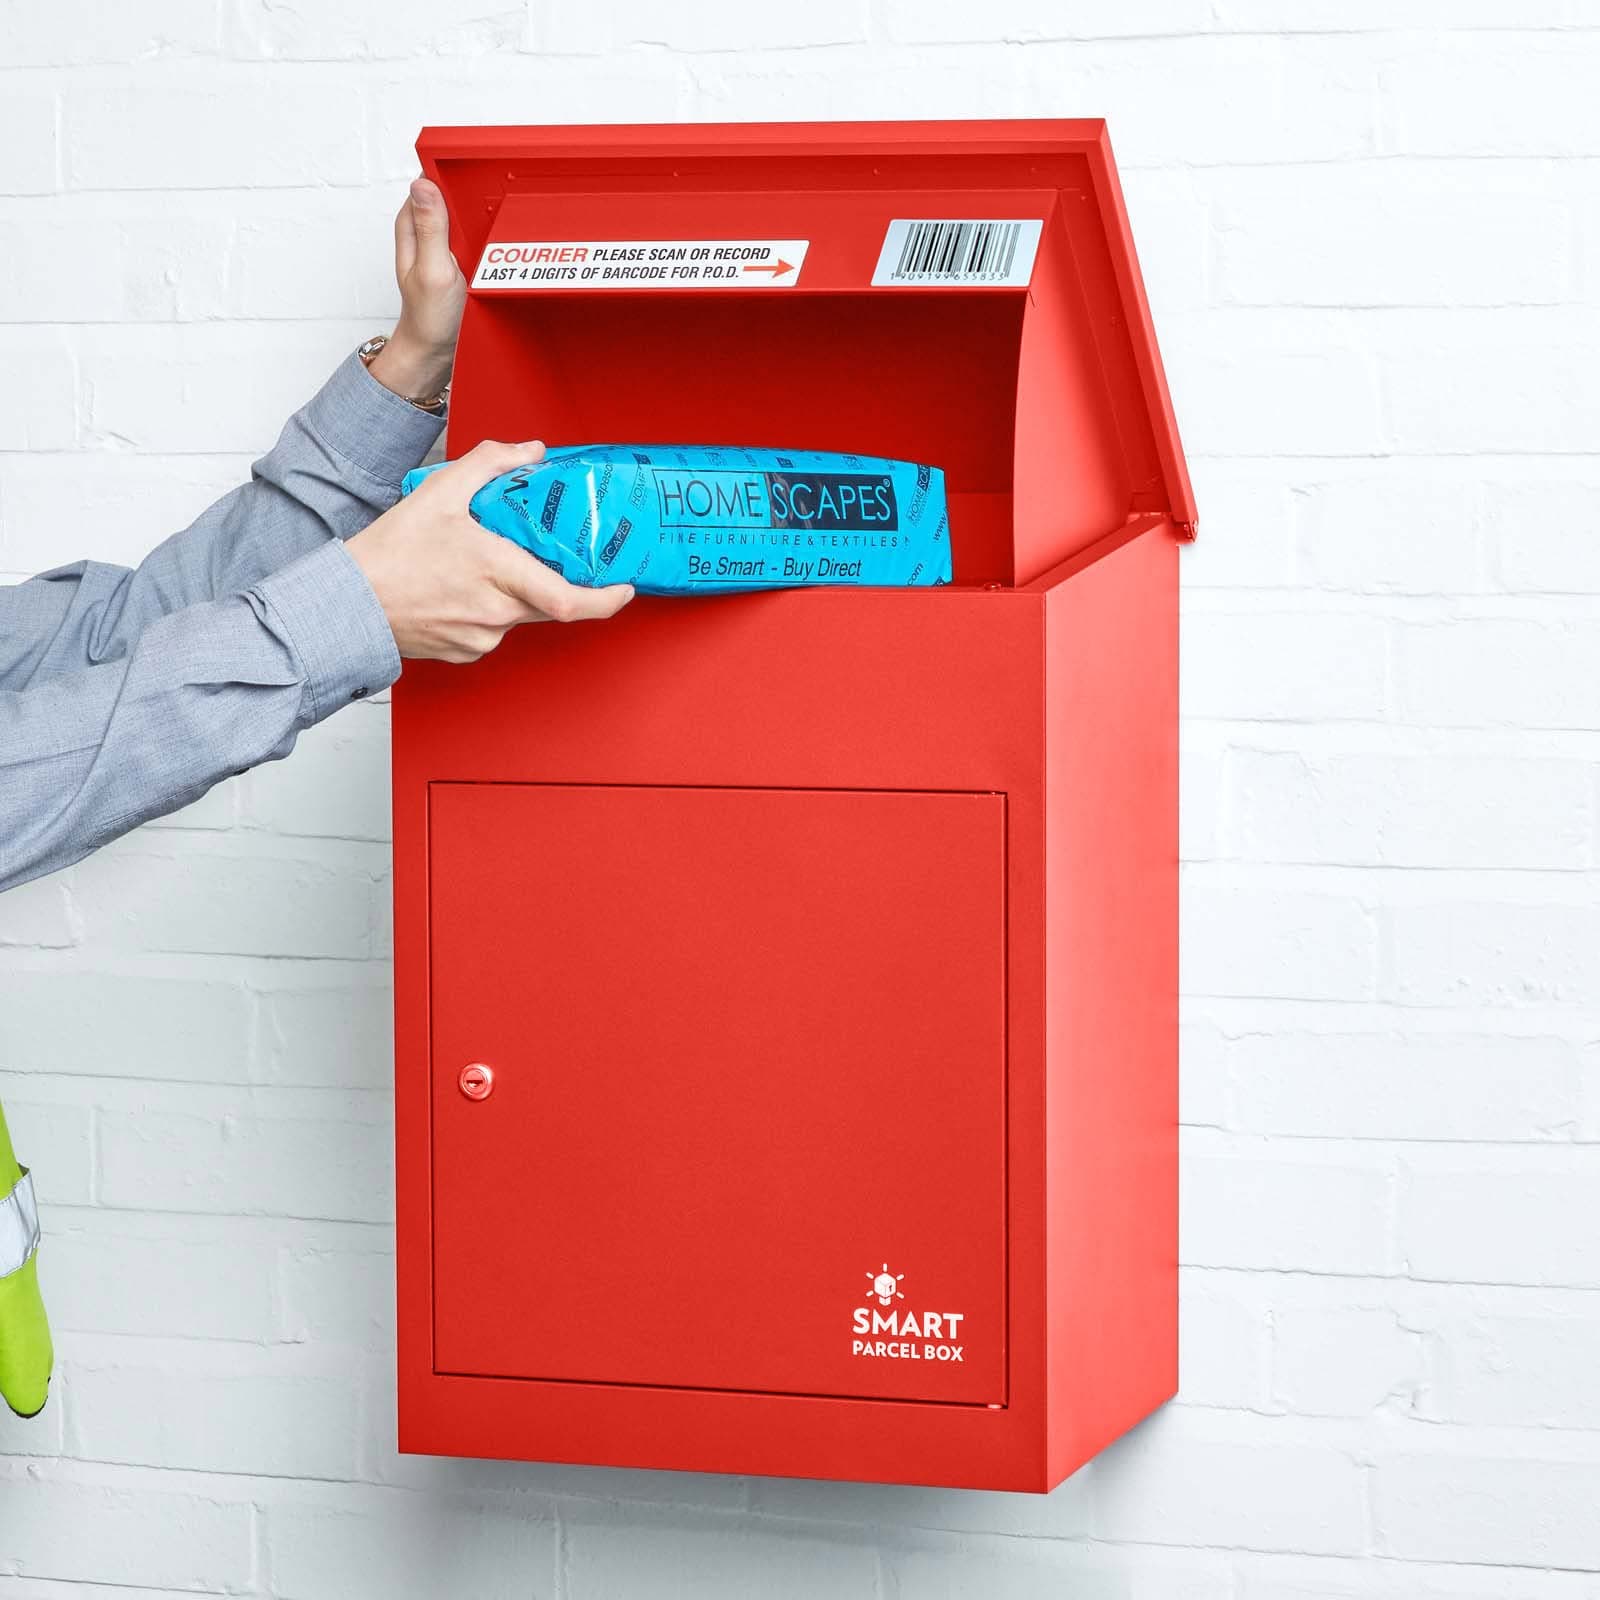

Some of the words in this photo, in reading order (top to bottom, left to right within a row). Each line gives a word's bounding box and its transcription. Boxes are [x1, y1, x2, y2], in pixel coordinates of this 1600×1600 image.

[487, 247, 589, 264] COURIER
[592, 248, 645, 261] PLEASE
[648, 248, 687, 261] SCAN
[690, 248, 710, 260] OR
[713, 247, 771, 260] RECORD
[481, 268, 518, 281] LAST
[519, 268, 528, 280] 4
[530, 267, 578, 280] DIGITS
[580, 267, 599, 279] OF
[602, 266, 669, 279] BARCODE
[670, 266, 699, 279] FOR
[702, 266, 740, 279] P.O.D.
[659, 533, 697, 545] FINE
[704, 533, 801, 546] FURNITURE
[807, 535, 815, 546] &
[820, 535, 898, 548] TEXTILES
[688, 555, 712, 576] Be
[716, 556, 765, 577] Smart
[783, 557, 812, 582] Buy
[817, 558, 862, 578] Direct
[852, 1307, 964, 1340] SMART
[852, 1340, 921, 1359] PARCEL
[924, 1344, 964, 1362] BOX
